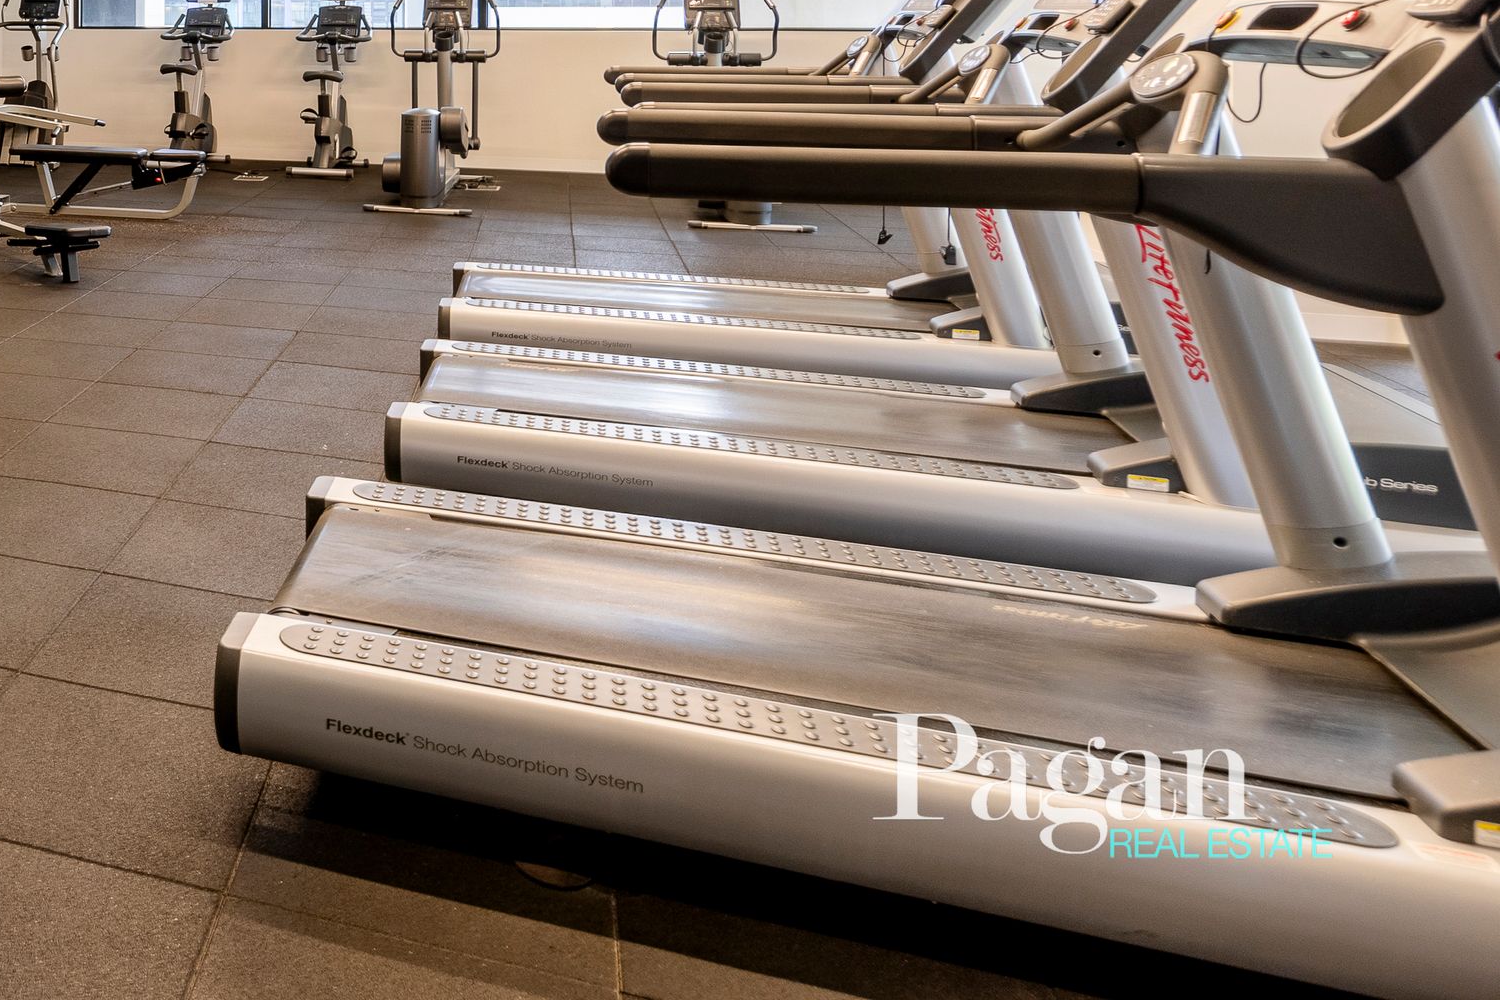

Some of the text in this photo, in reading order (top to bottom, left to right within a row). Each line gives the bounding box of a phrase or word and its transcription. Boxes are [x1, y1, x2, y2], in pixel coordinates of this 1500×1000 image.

[512, 461, 546, 473] Shock
[548, 466, 609, 481] Absorption
[611, 473, 654, 487] System
[1380, 478, 1439, 493] Series
[413, 735, 468, 758] Shock
[471, 747, 569, 778] Absorption
[575, 767, 644, 793] System
